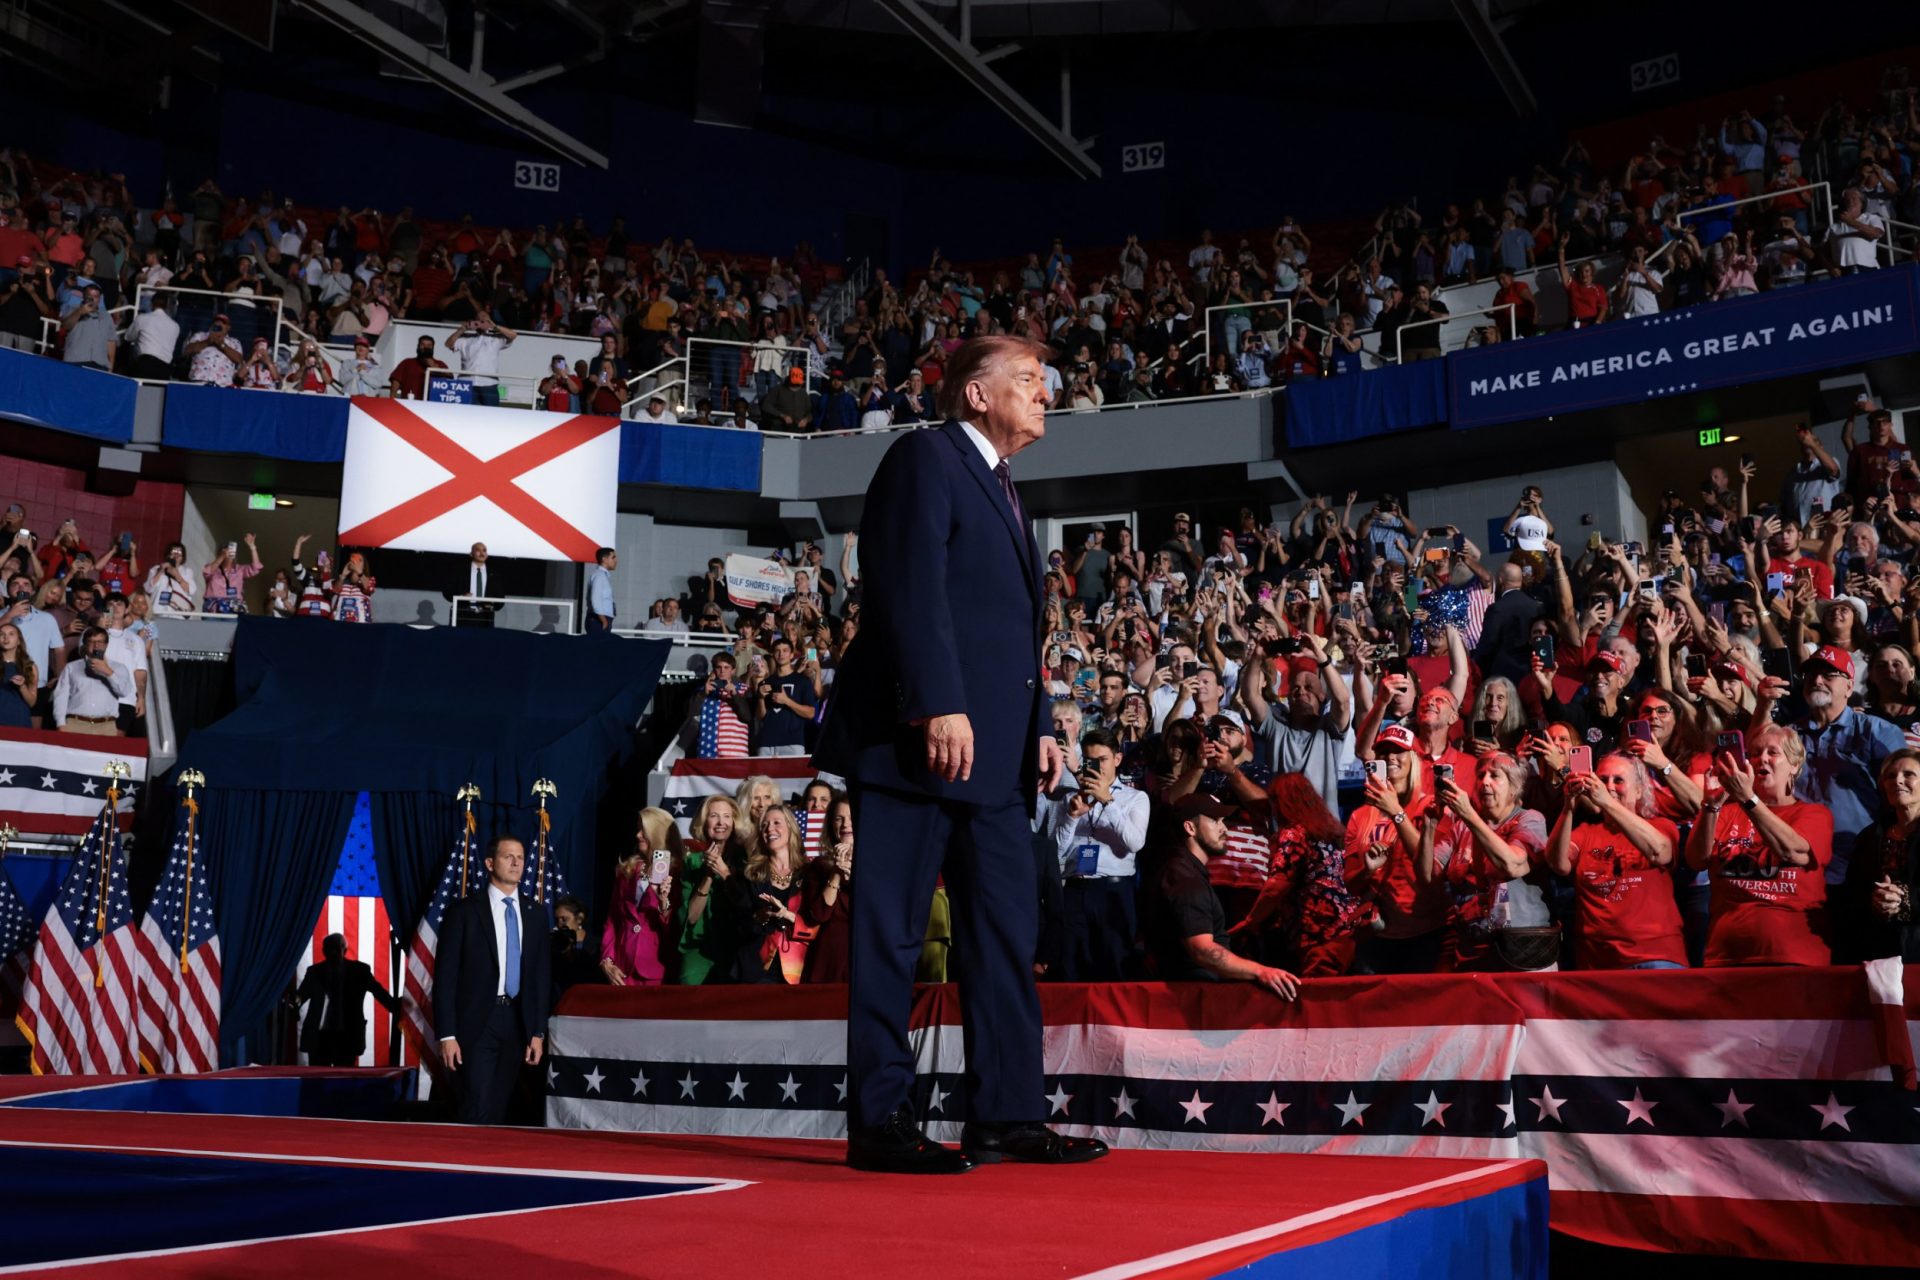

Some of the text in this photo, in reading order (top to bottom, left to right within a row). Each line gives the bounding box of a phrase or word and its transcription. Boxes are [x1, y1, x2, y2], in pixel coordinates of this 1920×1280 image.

[1632, 59, 1677, 87] 320
[1124, 146, 1162, 168] 319
[516, 165, 558, 188] 318
[1470, 304, 1894, 397] MAKE AMERICA GREAT AGAIN!
[433, 381, 470, 392] NO TAX
[440, 394, 461, 403] TIPS
[1700, 427, 1721, 447] EXIT
[1527, 528, 1544, 538] USA
[744, 579, 770, 591] SHORES
